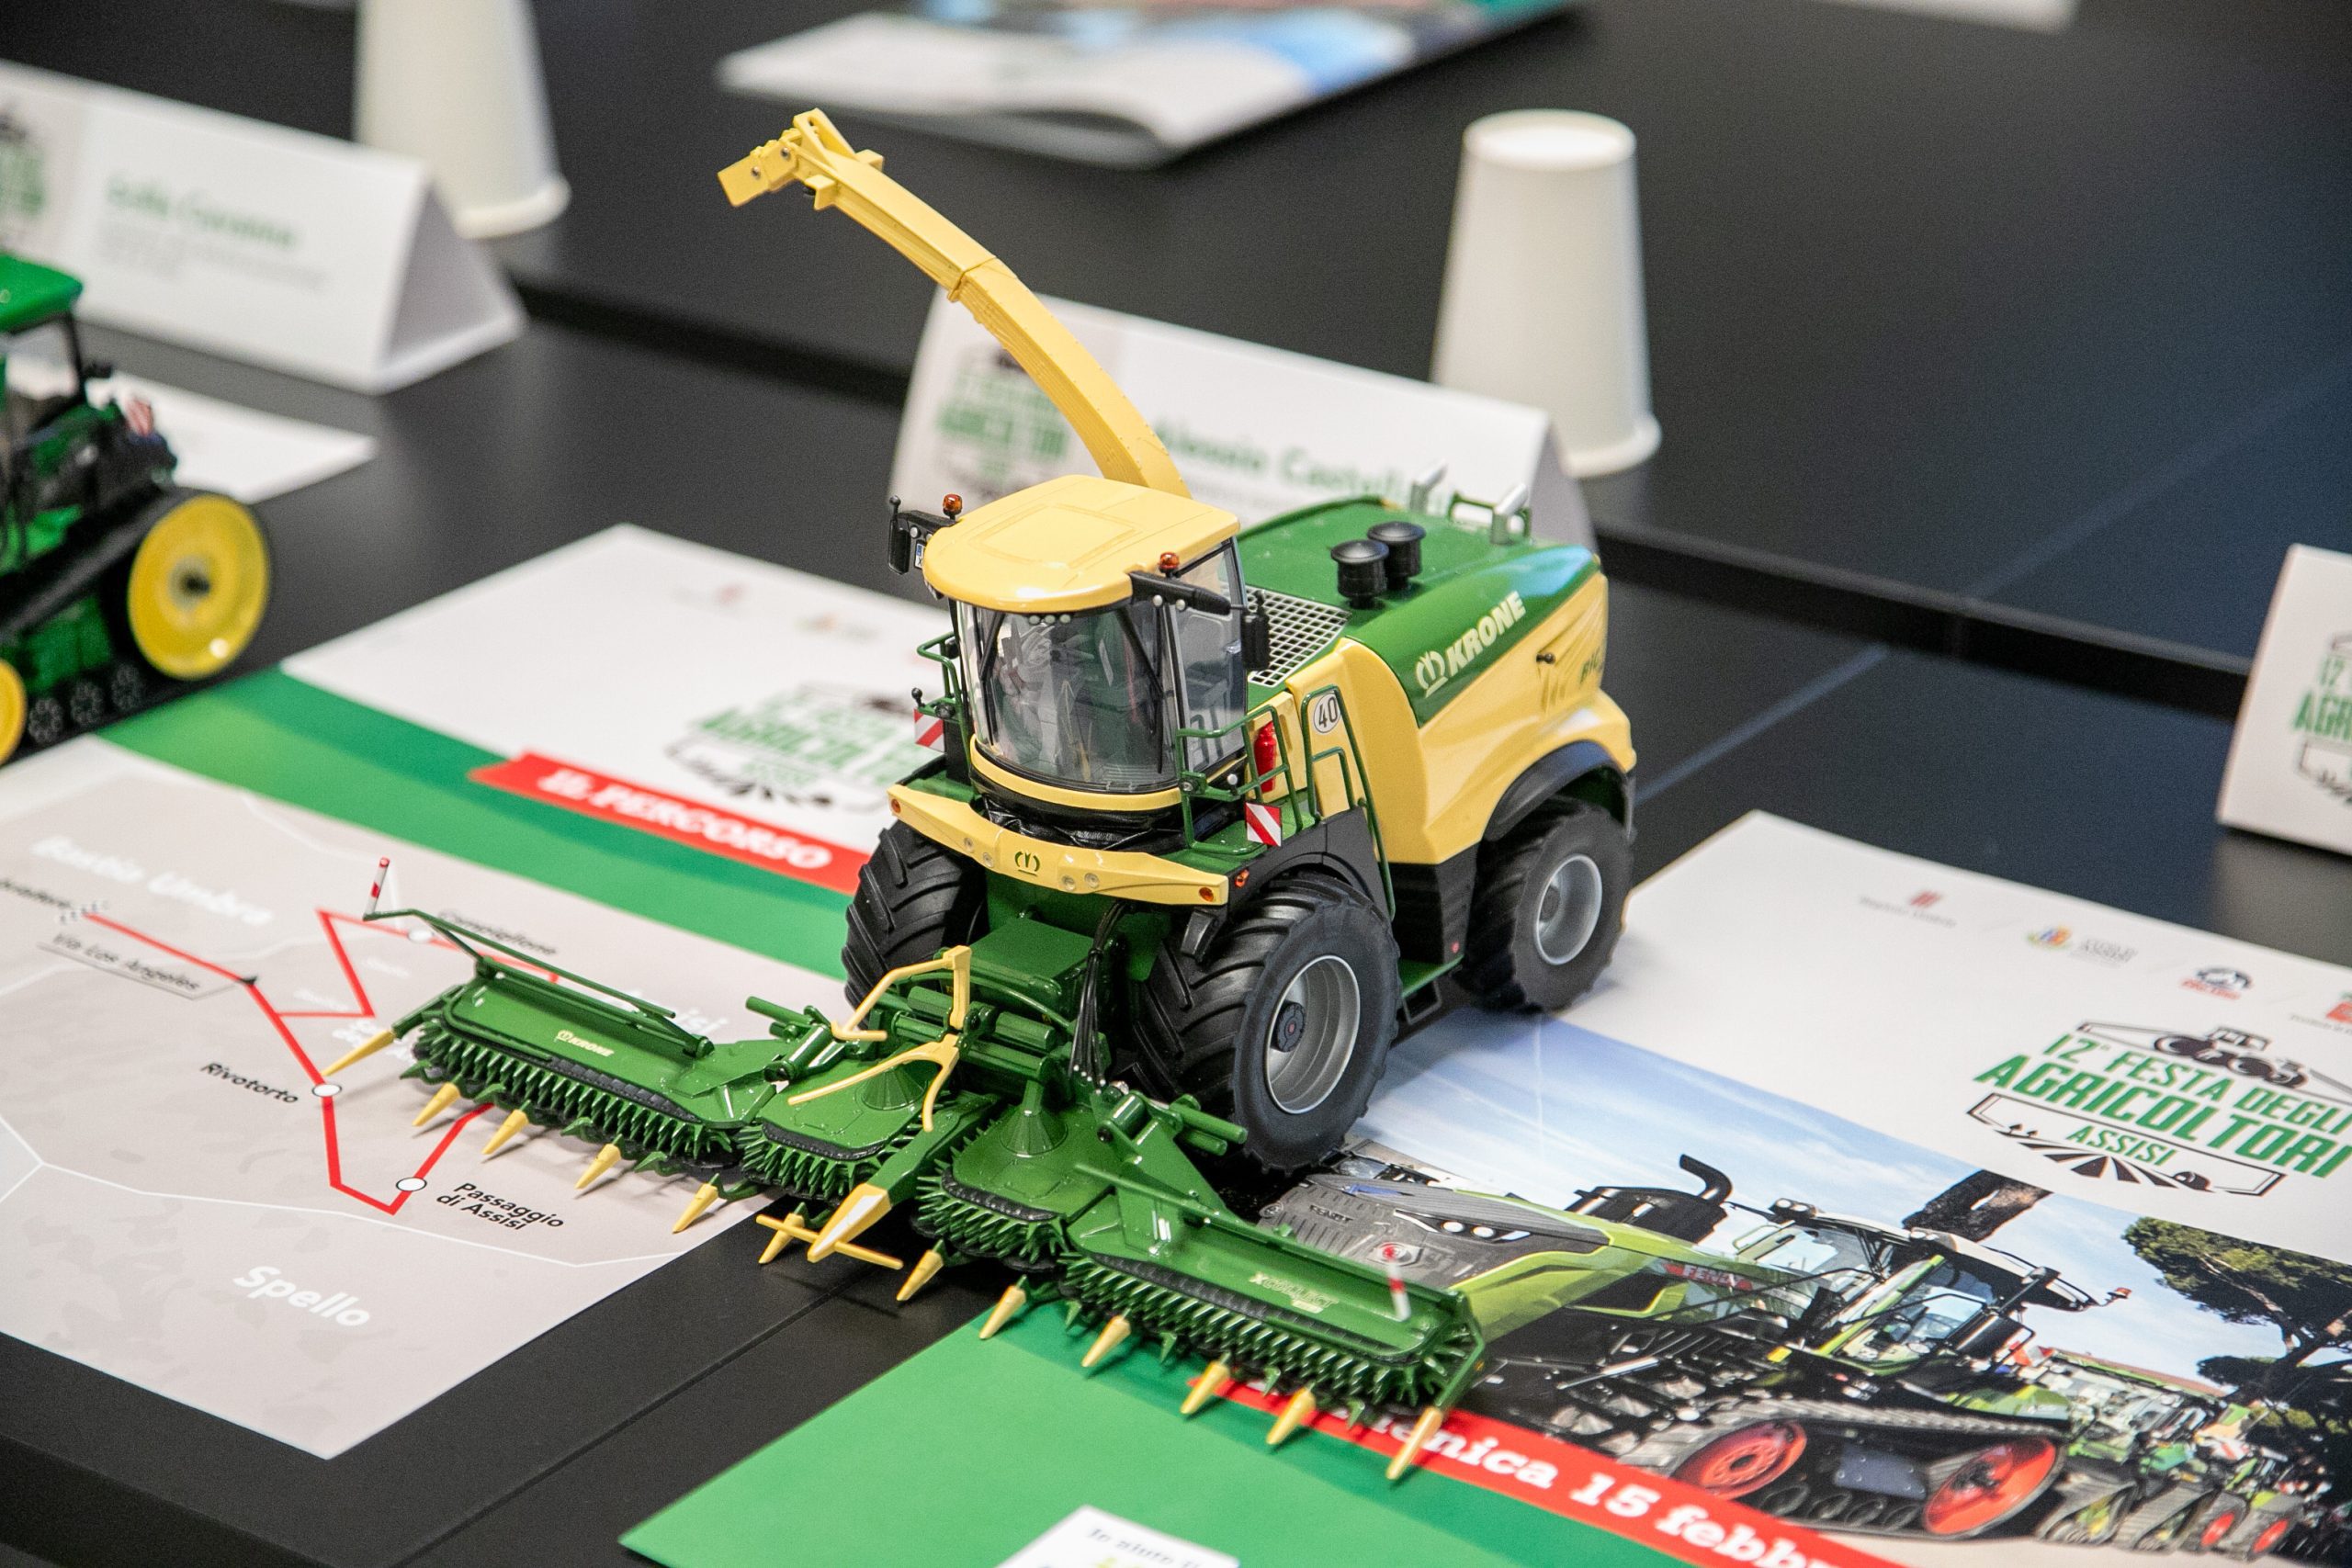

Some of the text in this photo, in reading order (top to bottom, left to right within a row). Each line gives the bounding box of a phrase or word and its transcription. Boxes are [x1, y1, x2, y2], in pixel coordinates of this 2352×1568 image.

[1446, 591, 1526, 678] KRONE
[1317, 694, 1339, 728] 40
[589, 784, 832, 869] PERCORSO
[124, 959, 201, 992] Angeles
[199, 1061, 299, 1104] Rivotorto
[2103, 1050, 2234, 1102] FESTA
[2233, 1087, 2352, 1135] DEGLI
[1972, 1054, 2352, 1179] AGRICOLTORI
[2064, 1124, 2177, 1166] ASSISI
[436, 1193, 529, 1231] di Assisi
[453, 1182, 564, 1229] Passaggio
[232, 1265, 370, 1328] Spello
[1568, 1472, 1661, 1517] 15
[1654, 1504, 1839, 1568] febb
